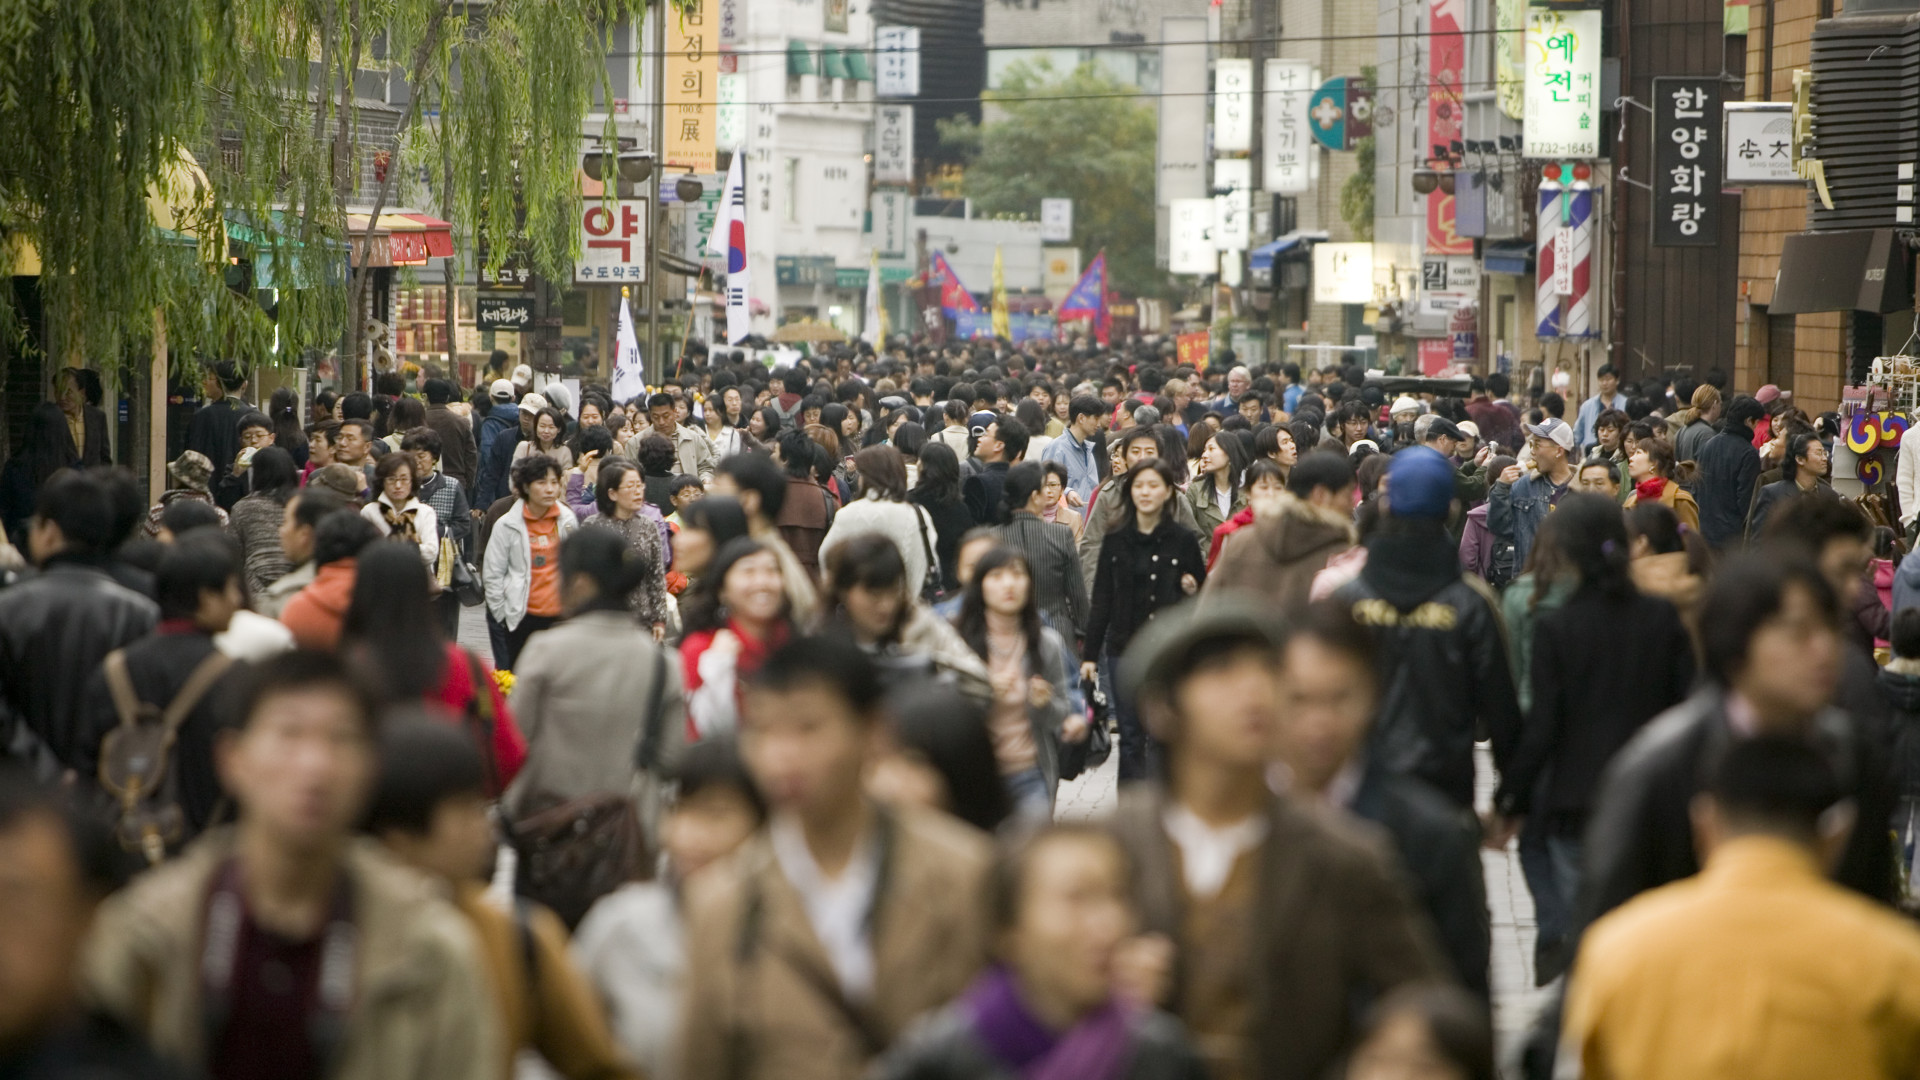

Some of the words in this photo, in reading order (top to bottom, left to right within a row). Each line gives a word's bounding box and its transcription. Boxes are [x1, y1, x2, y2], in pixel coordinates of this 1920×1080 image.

[1544, 33, 1574, 102] 예전
[680, 119, 700, 141] 展
[1276, 69, 1299, 176] 나누는기쁨
[1529, 142, 1593, 154] T.732-1645
[1670, 87, 1709, 236] 한양화랑
[583, 205, 639, 263] 약
[581, 266, 640, 279] 수도약국
[1424, 262, 1447, 291] 칼
[1448, 279, 1476, 287] GALLERY
[1453, 267, 1472, 275] KNIFE
